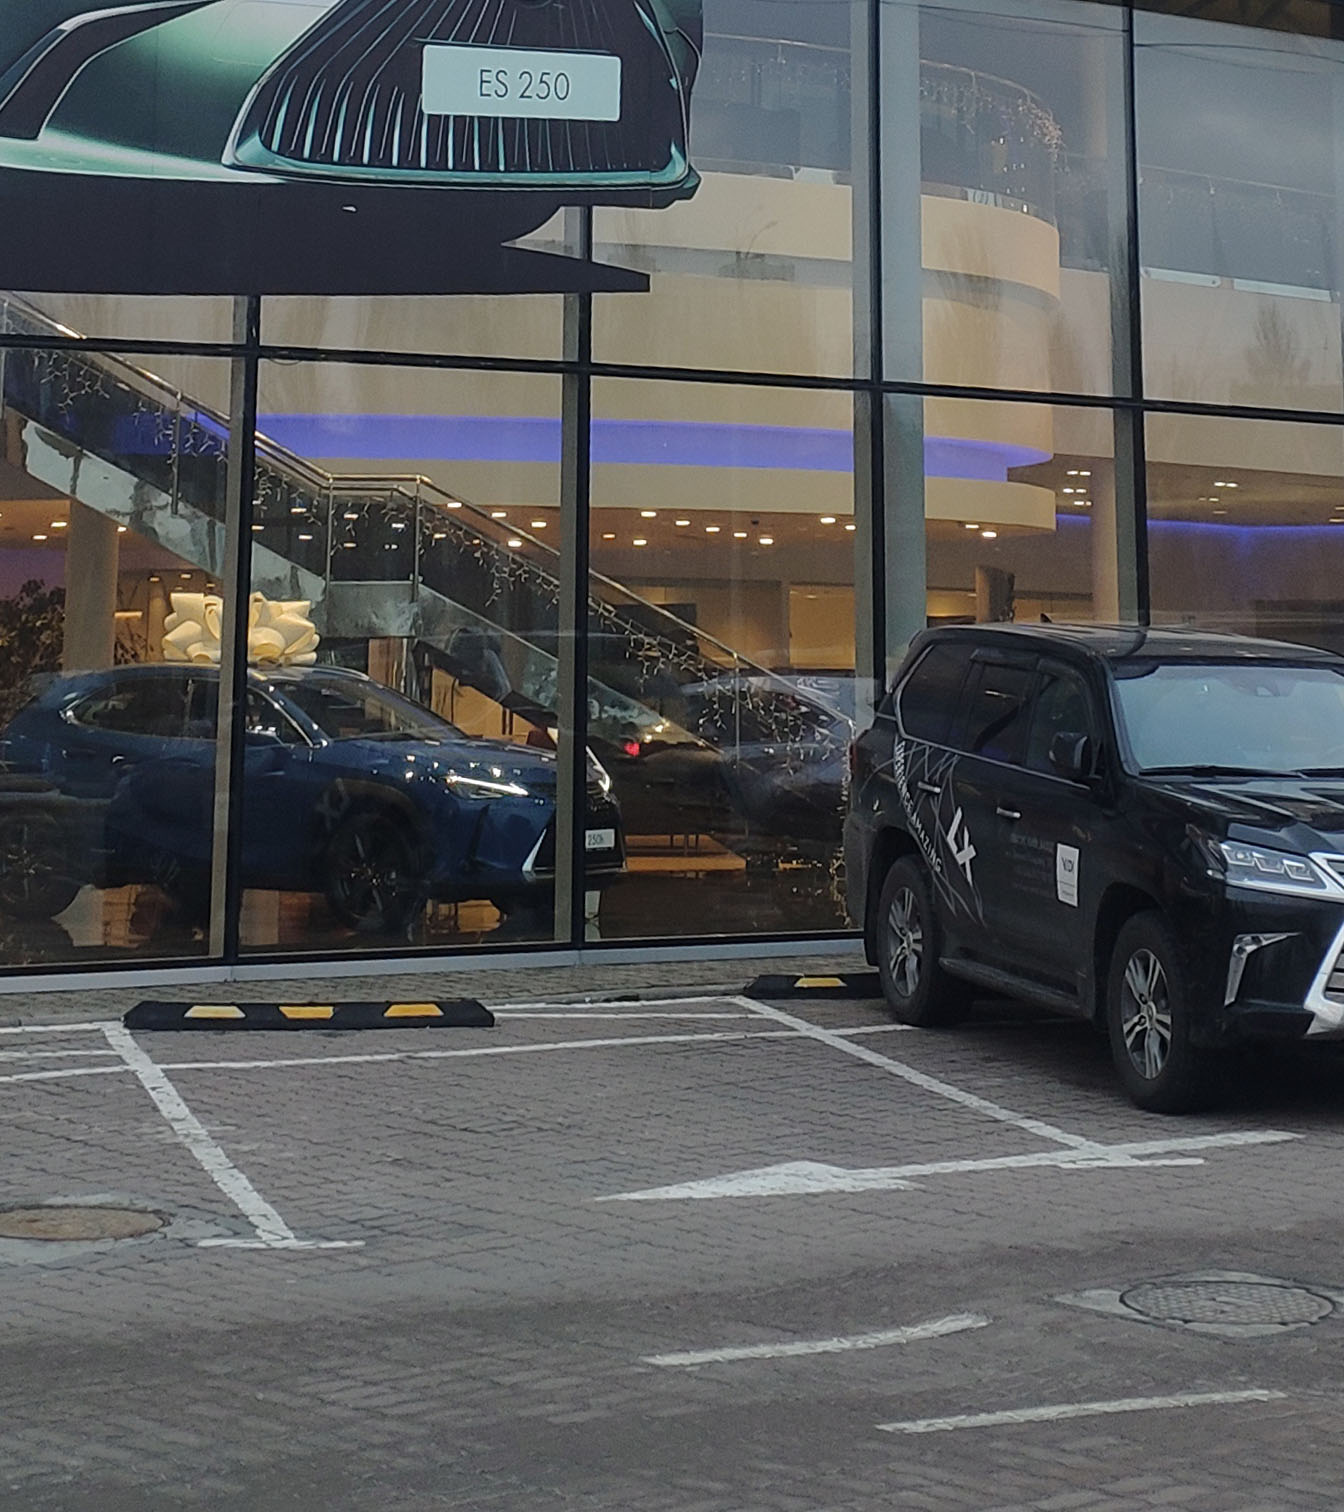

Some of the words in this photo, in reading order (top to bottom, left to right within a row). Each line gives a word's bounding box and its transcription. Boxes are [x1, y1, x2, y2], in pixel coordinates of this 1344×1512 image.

[479, 69, 509, 98] ES
[518, 70, 570, 101] 250
[946, 806, 977, 887] LX
